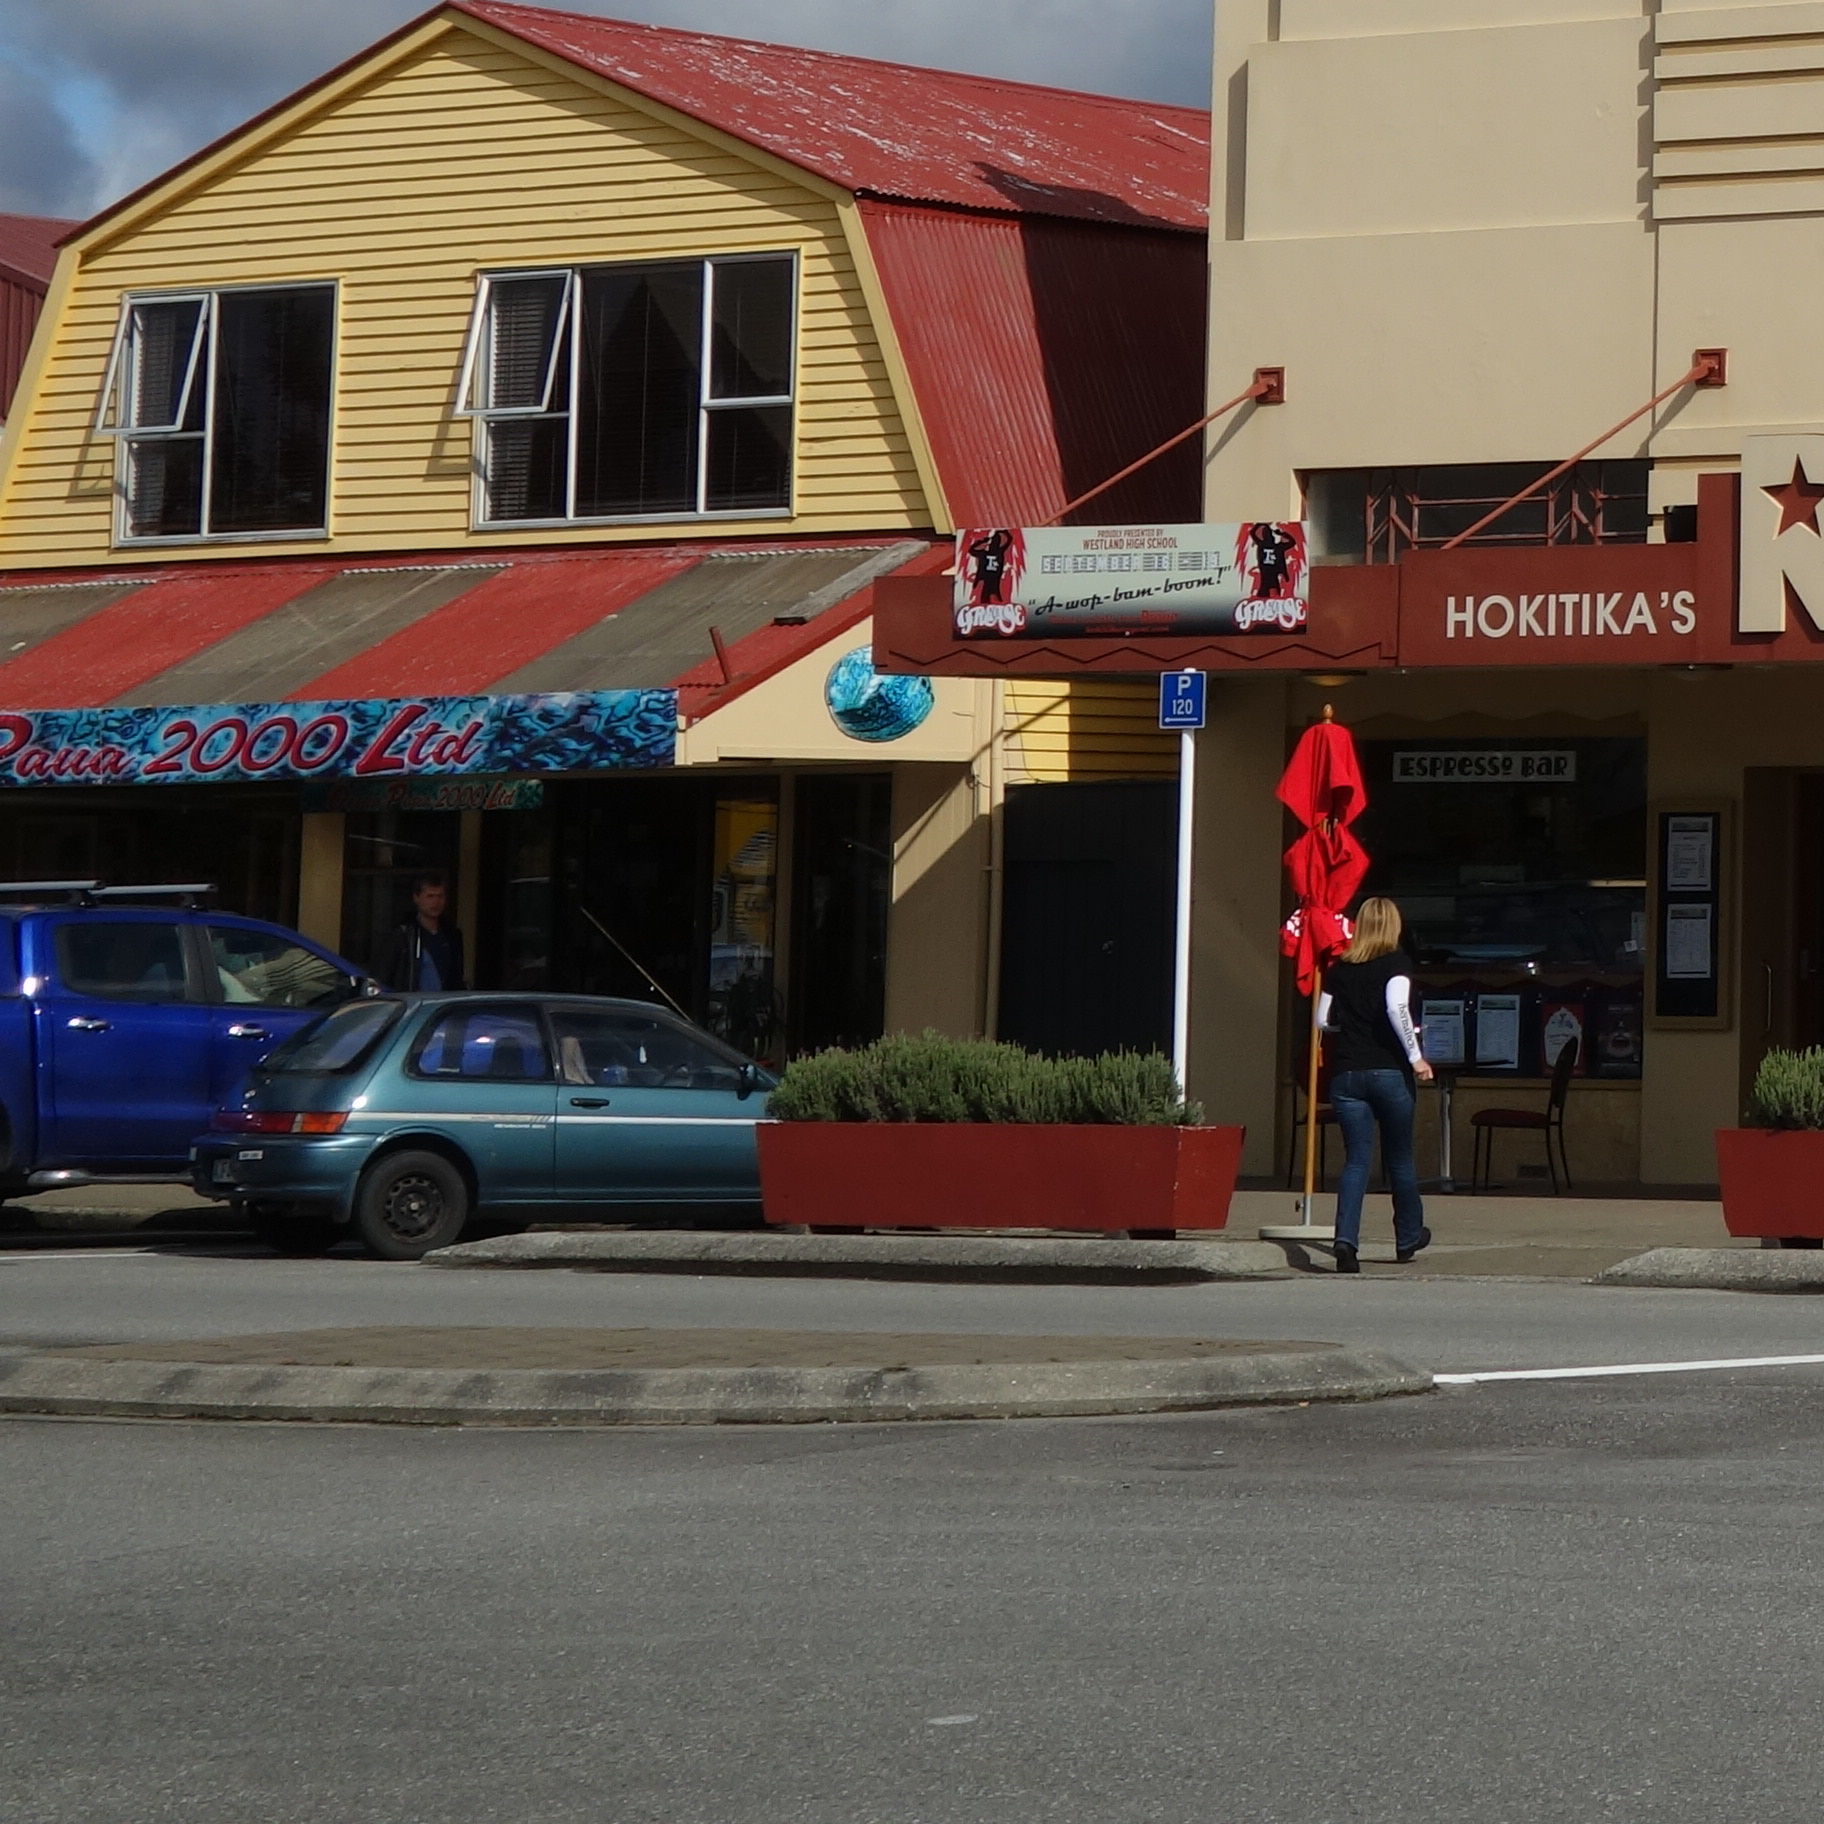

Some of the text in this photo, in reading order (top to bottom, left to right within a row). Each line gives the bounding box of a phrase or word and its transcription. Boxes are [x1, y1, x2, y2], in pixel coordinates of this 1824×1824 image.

[1083, 537, 1178, 551] WESTLAND HIGH SCHOOL
[1446, 590, 1696, 638] HOKITIKA'S
[1178, 675, 1191, 696] P
[1172, 698, 1193, 715] 120
[143, 715, 350, 775] 2000
[355, 704, 485, 775] Ltd
